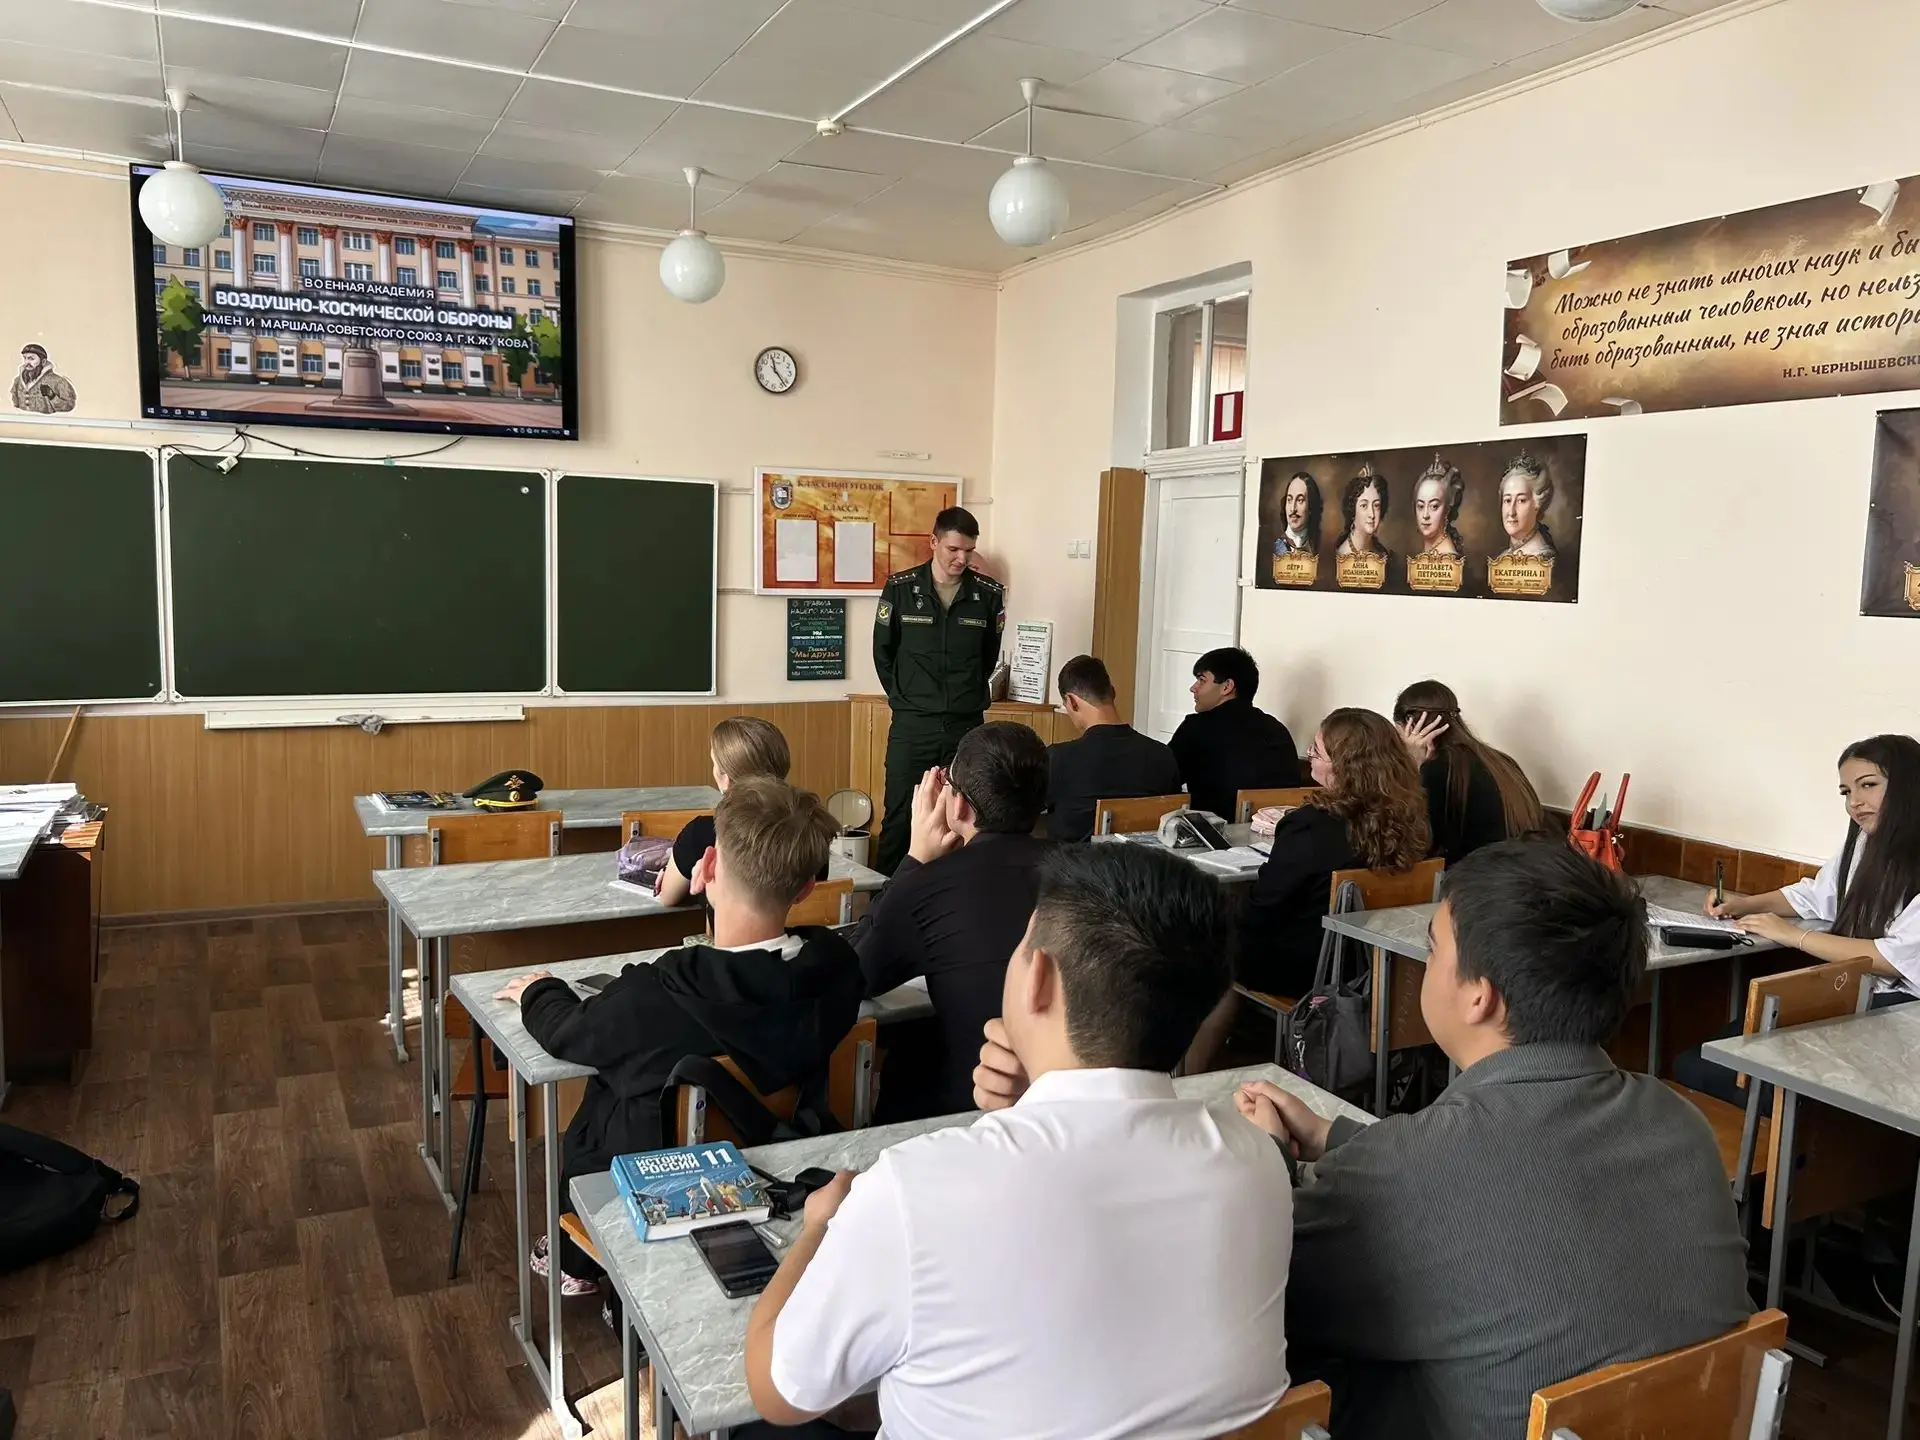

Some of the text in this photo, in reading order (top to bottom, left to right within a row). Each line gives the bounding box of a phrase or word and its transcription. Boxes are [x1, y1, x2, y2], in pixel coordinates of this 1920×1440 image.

[304, 278, 435, 299] ВОЕННАЯ АКАДЕМИЯ
[1554, 289, 1623, 315] Можно
[1627, 285, 1651, 301] не
[1650, 274, 1714, 306] знать
[1720, 258, 1799, 286] многих
[1804, 248, 1861, 277] наук
[1868, 244, 1884, 261] и
[215, 291, 512, 330] ВОЗДУШНО-КОСМИЧЕСКОЙ ОБОРОНЫ
[1562, 309, 1692, 345] образованным
[1699, 289, 1812, 320] человеком,
[1820, 284, 1850, 303] но
[202, 313, 255, 327] ИМЕНИ
[261, 319, 325, 333] МАРШАЛА
[327, 323, 405, 339] СОВЕТСКОГО
[407, 331, 453, 343] СОЮЗА
[1550, 348, 1589, 370] быть
[1595, 334, 1736, 369] образованным,
[1744, 328, 1769, 346] не
[1770, 321, 1828, 350] зная
[1783, 367, 1808, 378] Н.Г.
[823, 503, 858, 512] КЛАССА
[1416, 563, 1453, 571] ЕЛИЗАВЕТА
[1417, 570, 1452, 578] ПЕТРОВНА
[1494, 569, 1537, 577] ЕКАТЕРИНА
[635, 1152, 694, 1168] ИСТОРИЯ
[701, 1148, 733, 1165] 11
[640, 1159, 700, 1175] РОССИИ
